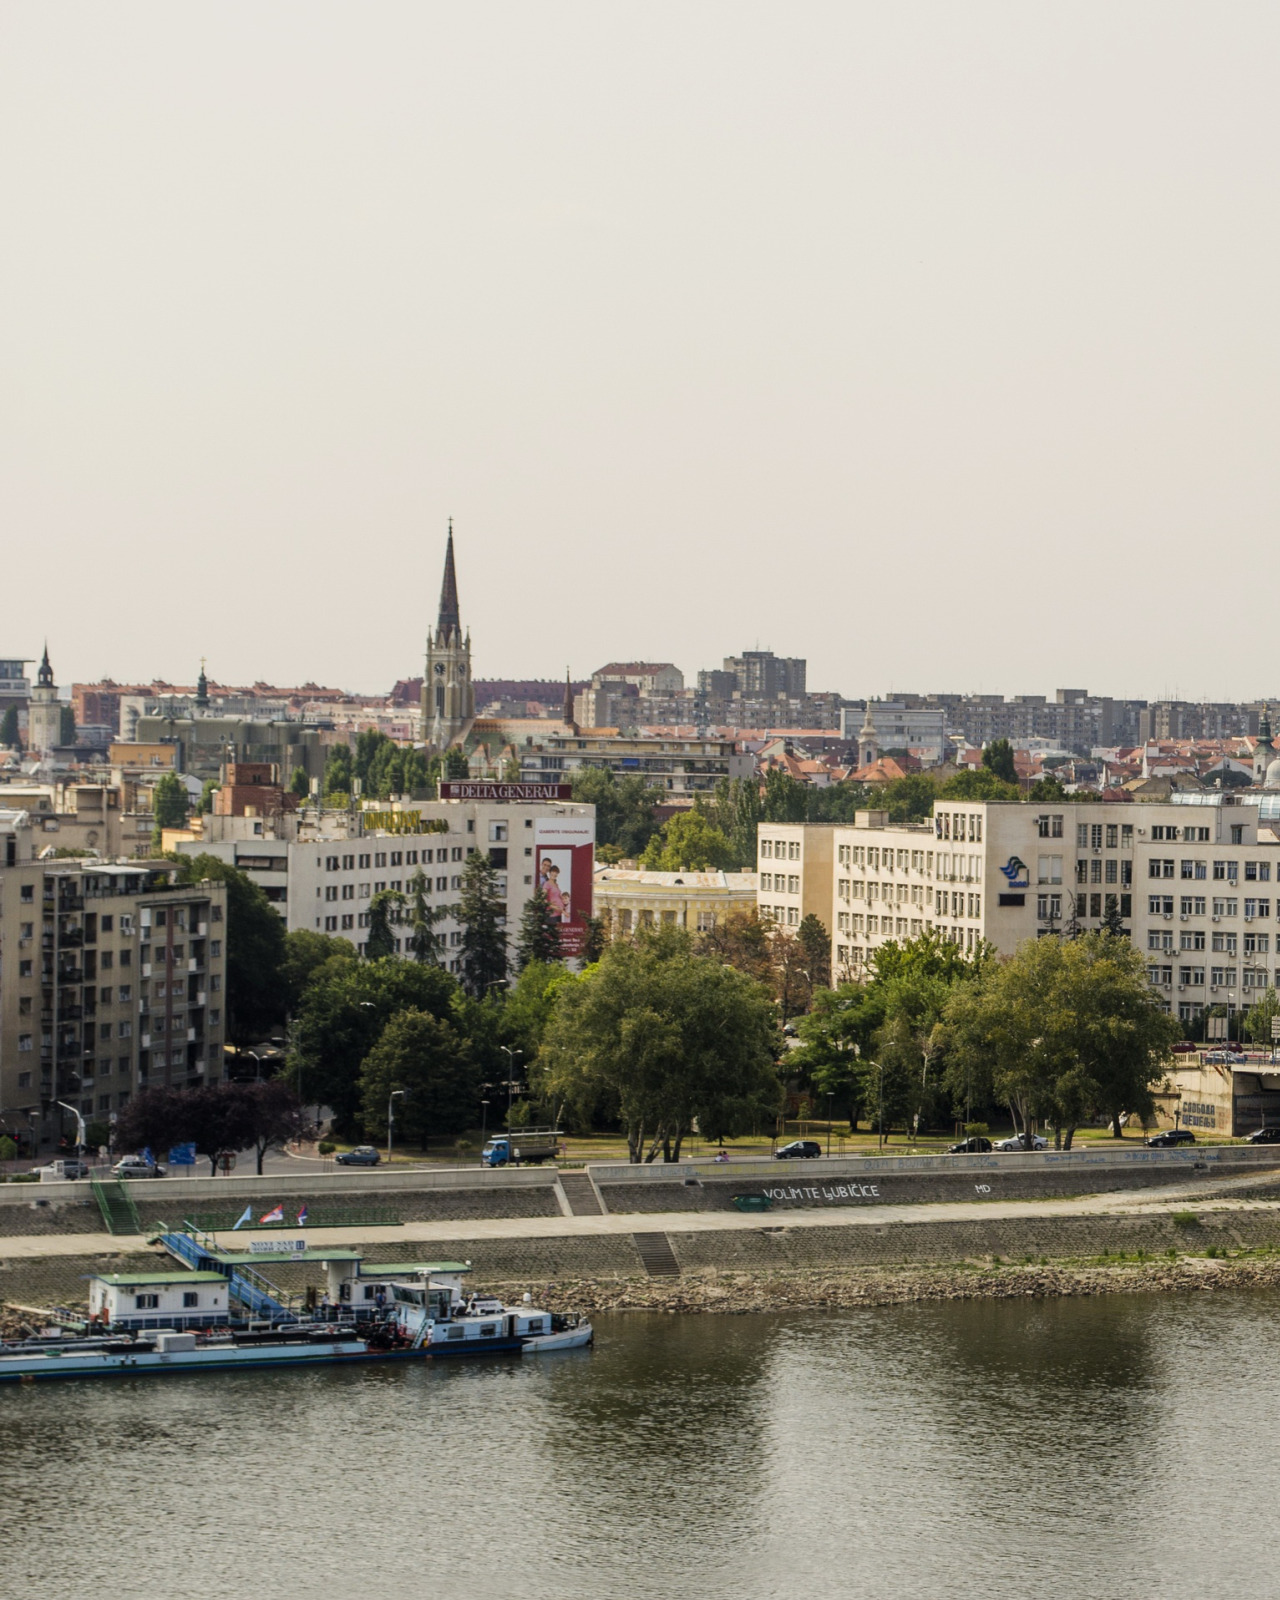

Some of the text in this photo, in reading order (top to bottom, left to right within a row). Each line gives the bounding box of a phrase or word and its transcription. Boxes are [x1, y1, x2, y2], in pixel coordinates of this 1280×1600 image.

[460, 785, 559, 798] DELTA GENERALI
[1182, 1101, 1215, 1116] СЛОБОДА
[763, 1186, 803, 1200] VOLIM
[803, 1187, 820, 1200] TE
[974, 1184, 991, 1194] MD
